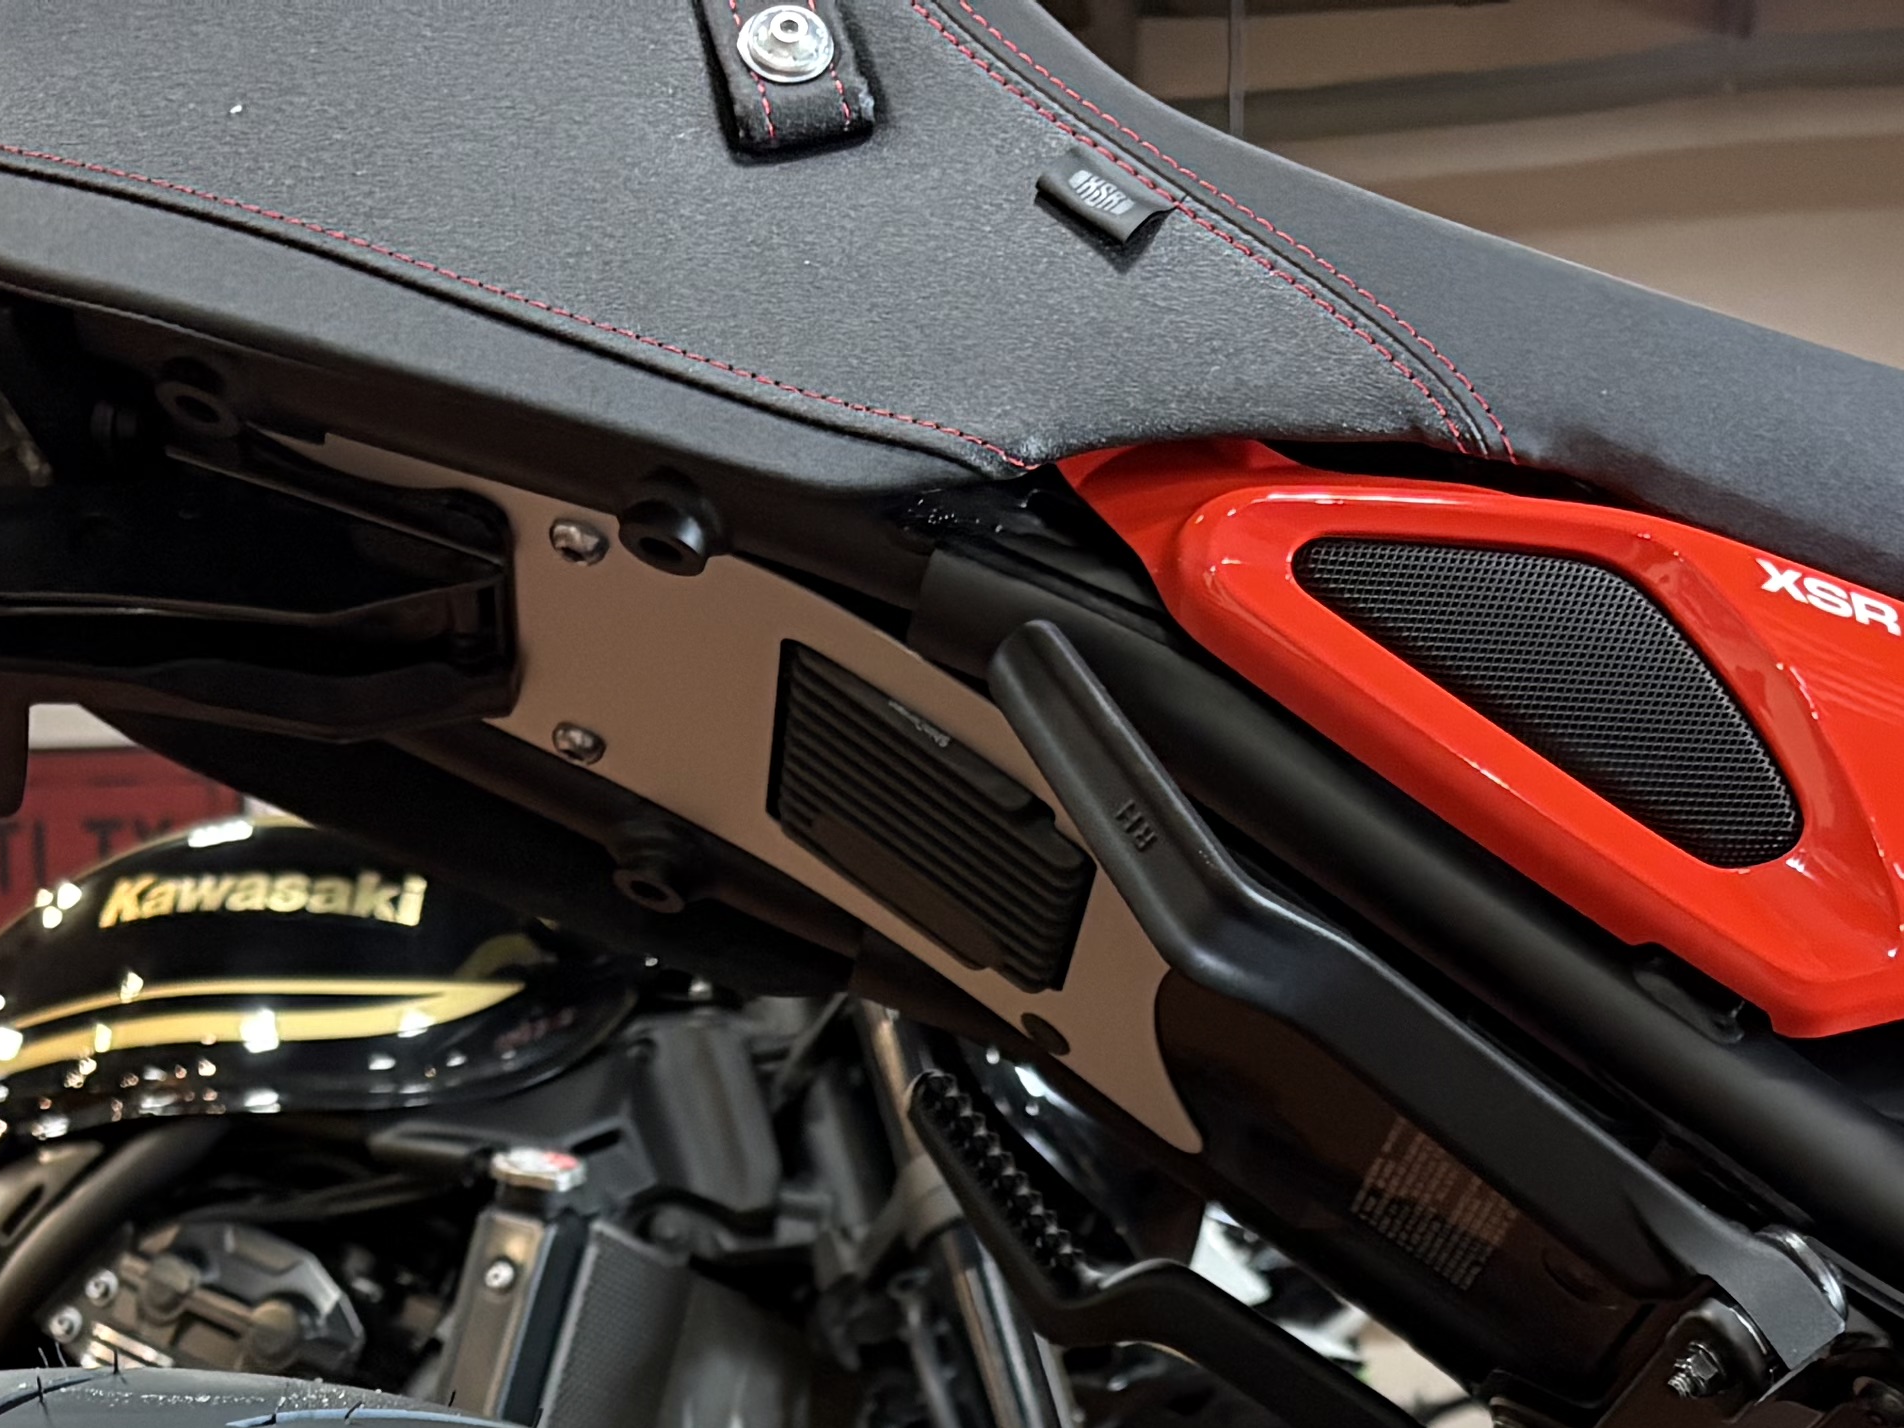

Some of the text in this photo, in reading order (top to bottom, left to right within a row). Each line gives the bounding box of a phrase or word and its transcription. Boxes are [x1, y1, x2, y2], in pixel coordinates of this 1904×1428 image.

[1076, 175, 1127, 211] XSR
[1756, 559, 1901, 637] XSR
[1114, 798, 1158, 852] RH
[98, 868, 428, 930] Kawasaki
